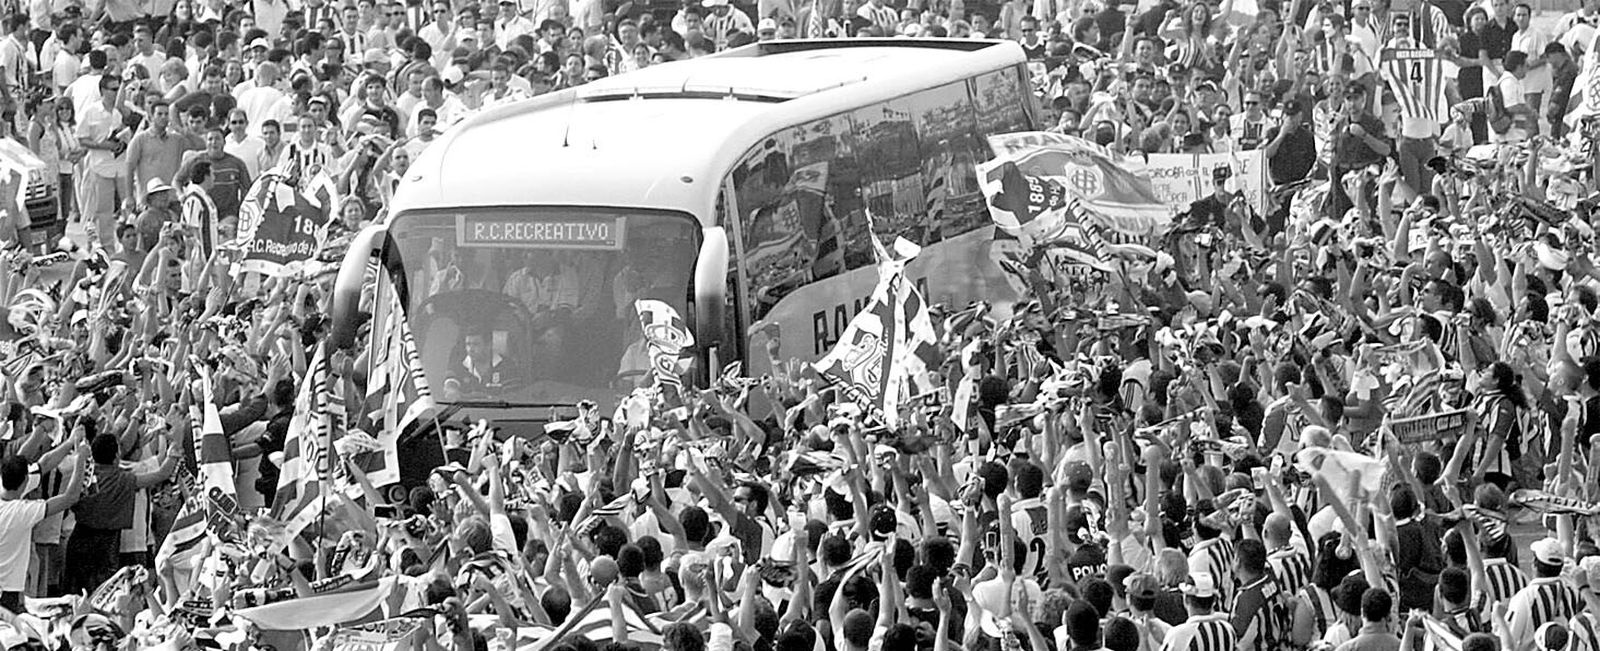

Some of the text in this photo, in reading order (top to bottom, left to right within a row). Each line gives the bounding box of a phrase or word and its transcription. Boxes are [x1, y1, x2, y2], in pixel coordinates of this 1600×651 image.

[1410, 61, 1423, 84] 4
[474, 222, 610, 241] R.C.RECREATIVO
[1072, 563, 1107, 581] POLIC
